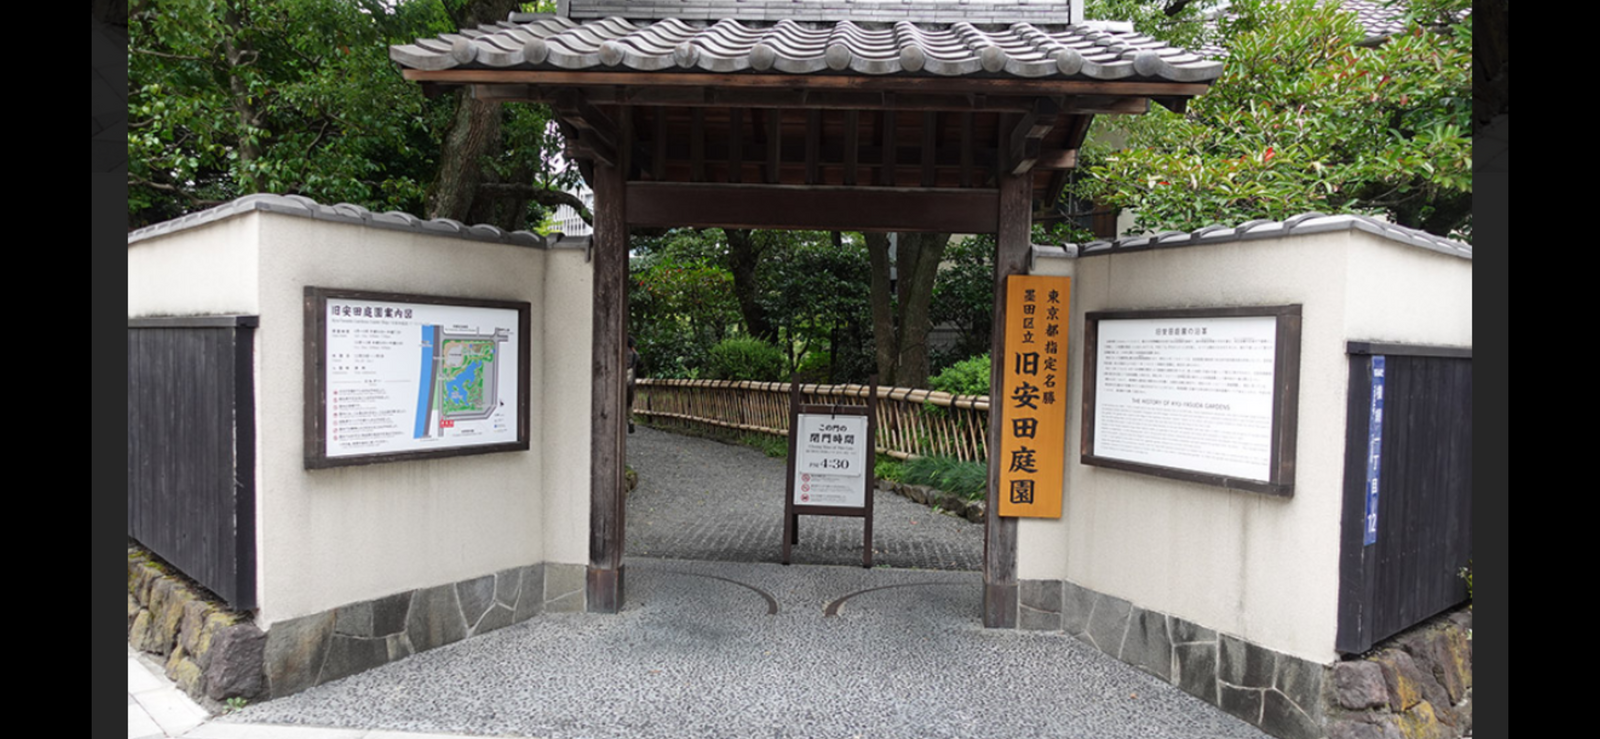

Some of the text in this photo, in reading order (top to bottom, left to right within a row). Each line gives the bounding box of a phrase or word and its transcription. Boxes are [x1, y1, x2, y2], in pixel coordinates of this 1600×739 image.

[332, 305, 413, 319] 旧安田庭園案内図
[1042, 289, 1060, 405] 東京都指定名勝
[1009, 288, 1041, 505] 墨田区立 旧安田庭園
[819, 424, 848, 432] この門の
[820, 458, 850, 469] 4:30
[1367, 513, 1377, 533] 12
